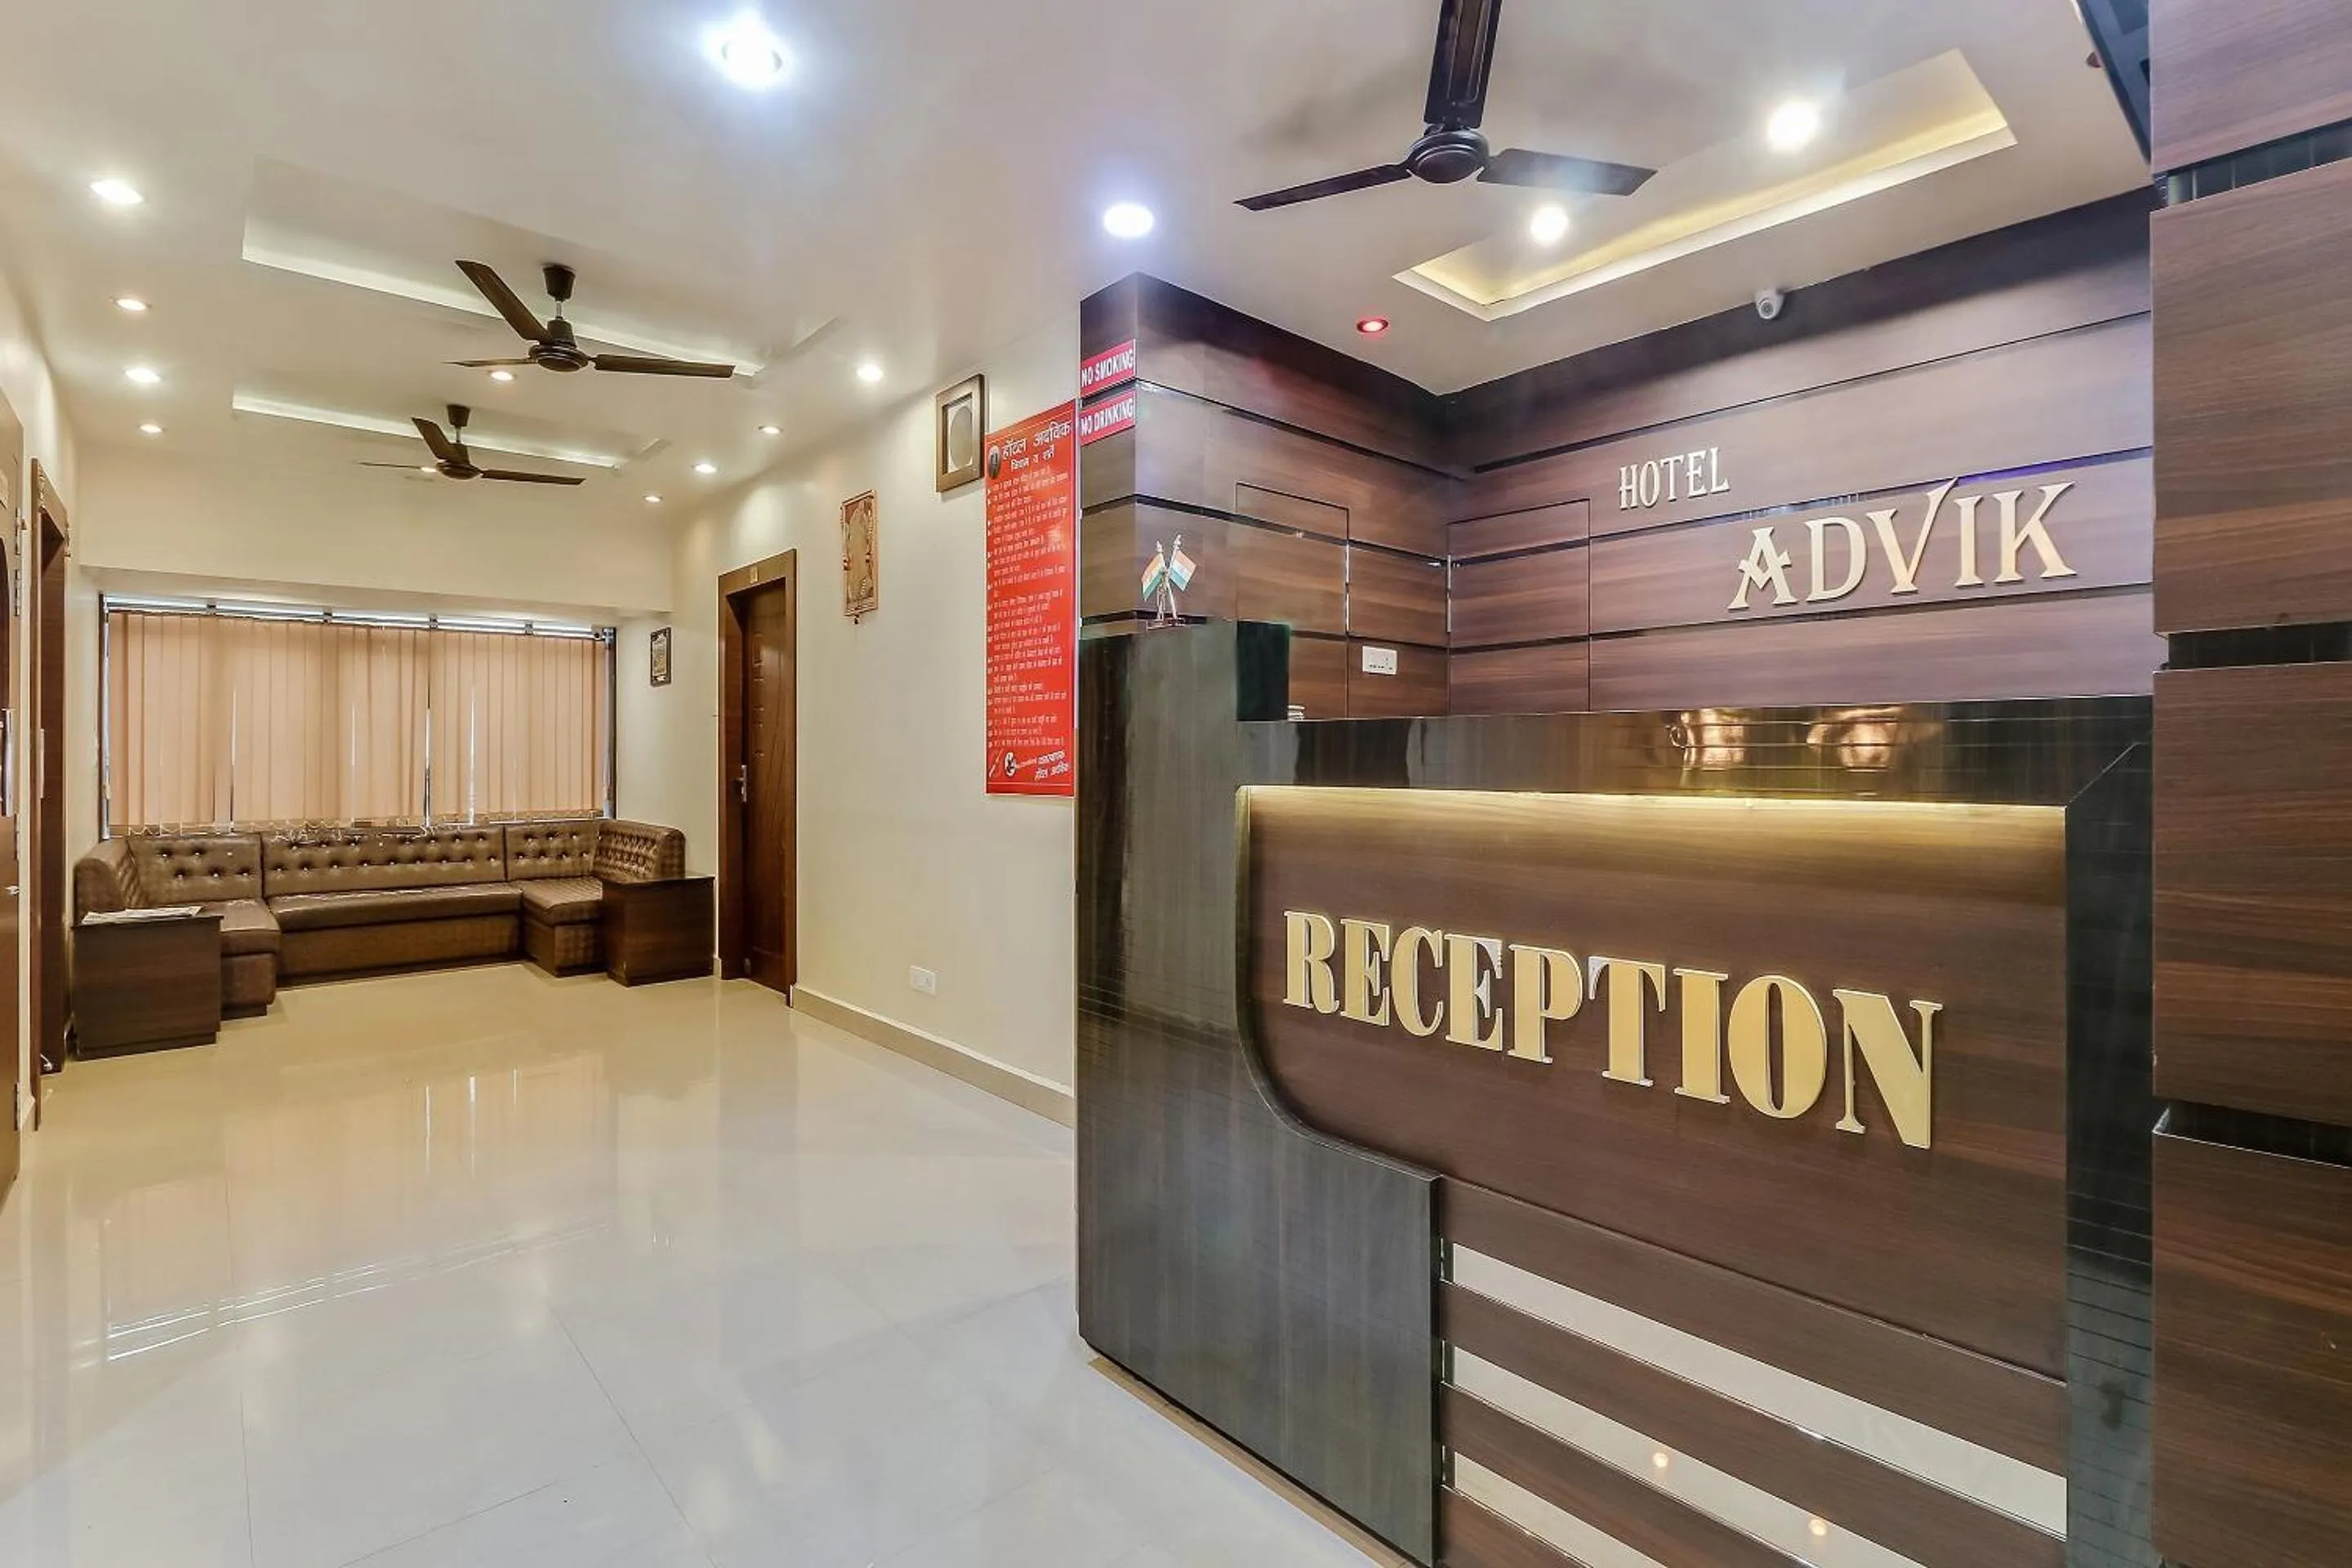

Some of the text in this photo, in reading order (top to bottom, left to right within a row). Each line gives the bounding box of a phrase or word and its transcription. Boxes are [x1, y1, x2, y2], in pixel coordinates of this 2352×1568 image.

[1080, 349, 1134, 388] NO SMOKING
[1080, 398, 1134, 436] NO DRINKING
[1619, 447, 1731, 510] HOTEL
[1727, 476, 2078, 611] ADVIK
[1283, 910, 1943, 1149] RECEPTION
